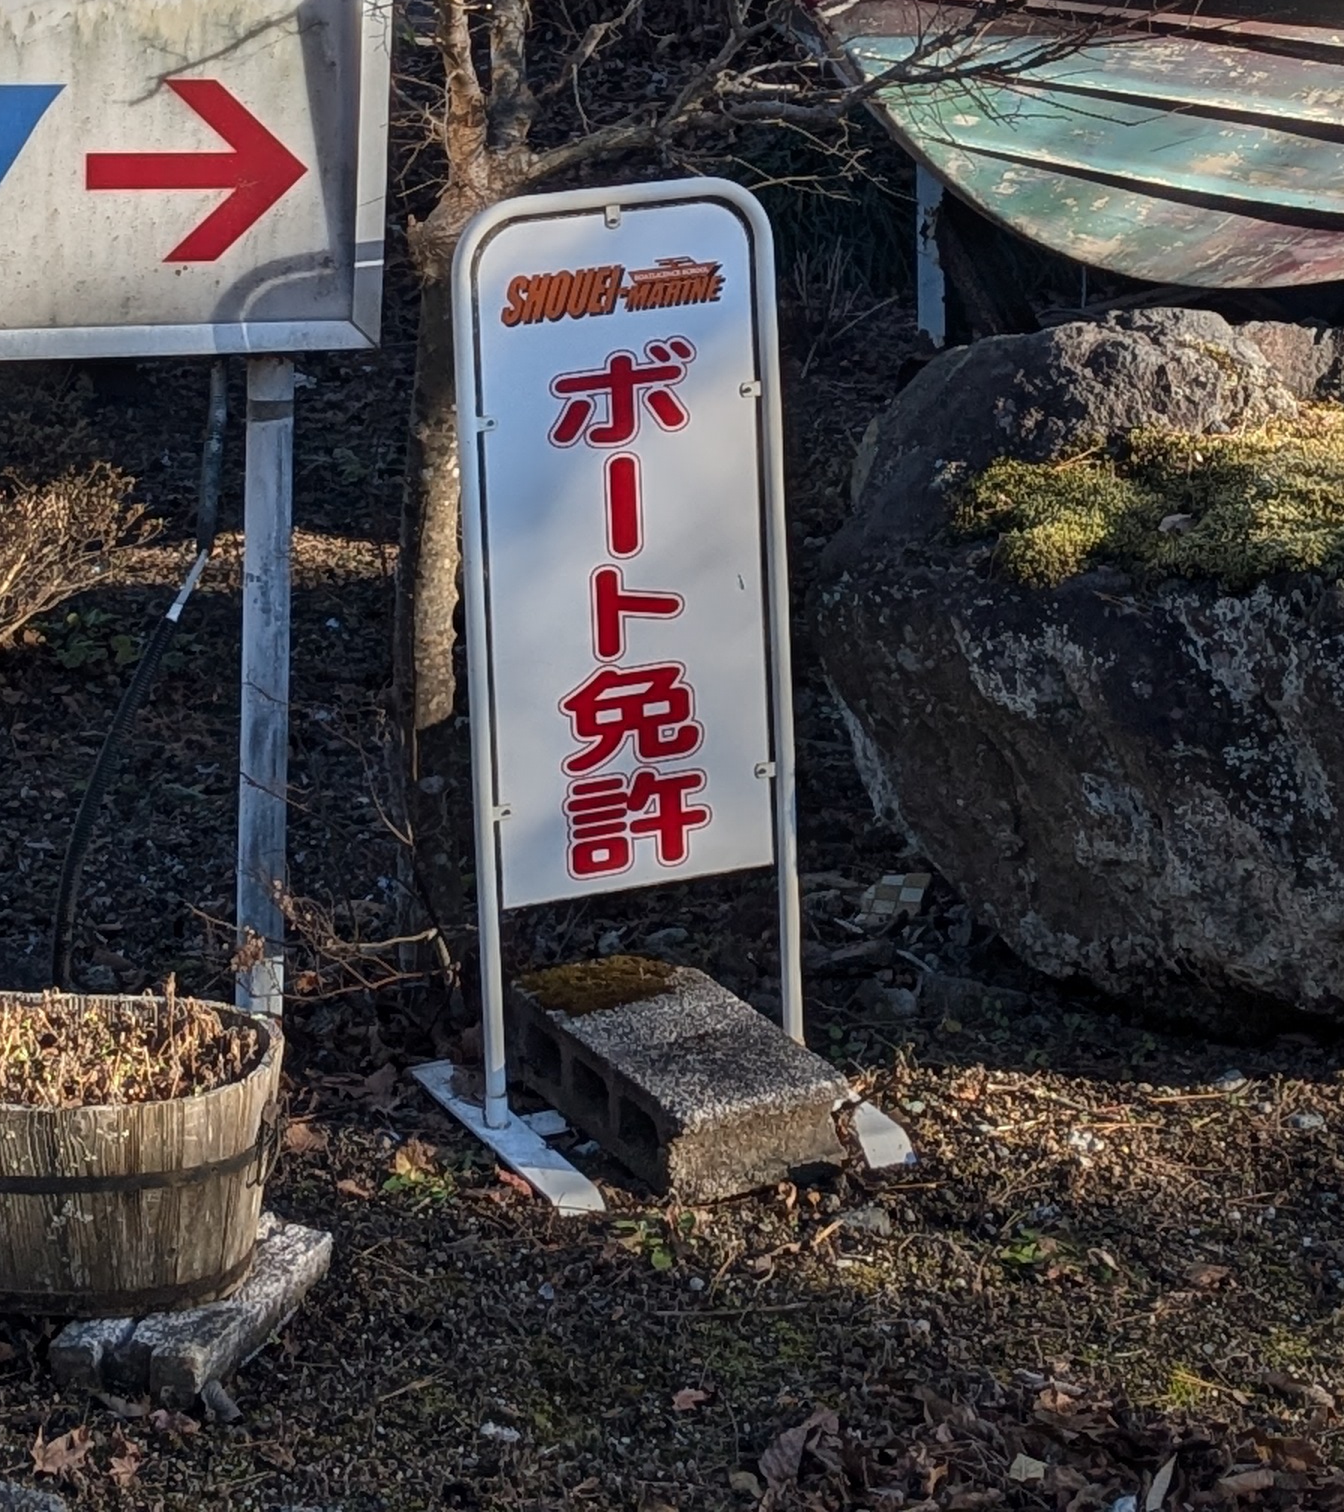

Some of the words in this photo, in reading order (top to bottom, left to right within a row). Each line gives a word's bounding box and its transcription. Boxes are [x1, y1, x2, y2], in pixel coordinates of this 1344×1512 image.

[550, 335, 712, 880] ボート免許
